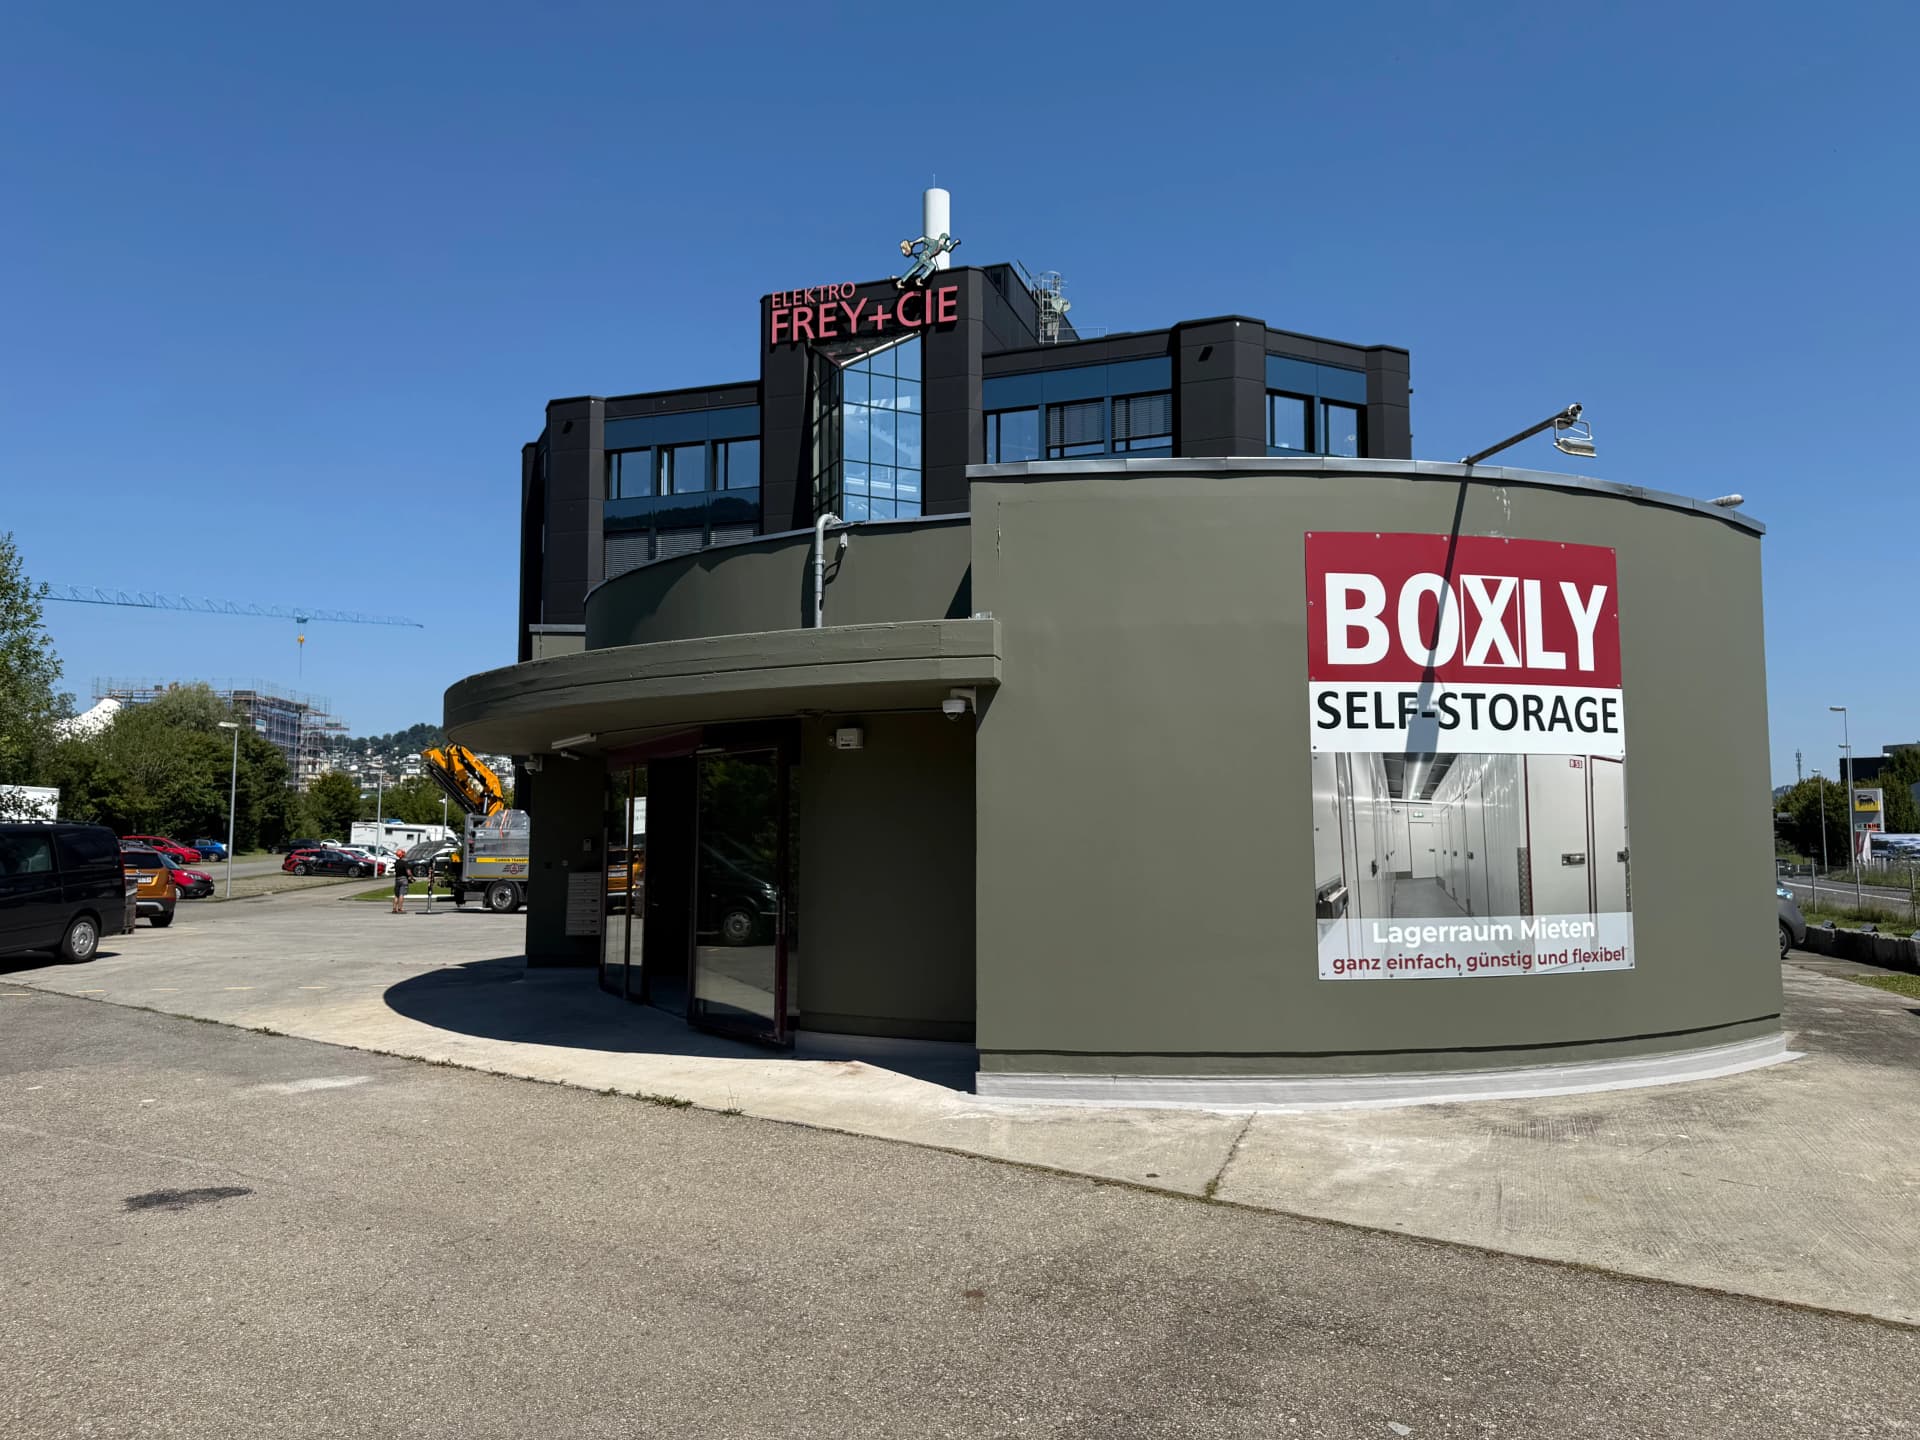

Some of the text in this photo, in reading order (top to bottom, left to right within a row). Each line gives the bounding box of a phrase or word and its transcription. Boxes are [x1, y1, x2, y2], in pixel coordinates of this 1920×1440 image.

[771, 281, 856, 308] ELEKTRO
[1325, 572, 1608, 671] BOXLY
[1316, 690, 1619, 734] SELF-STORAGE
[1372, 917, 1596, 948] Lagerraum Mieten
[1333, 946, 1626, 974] ganz einfach, günstig und flexibel
